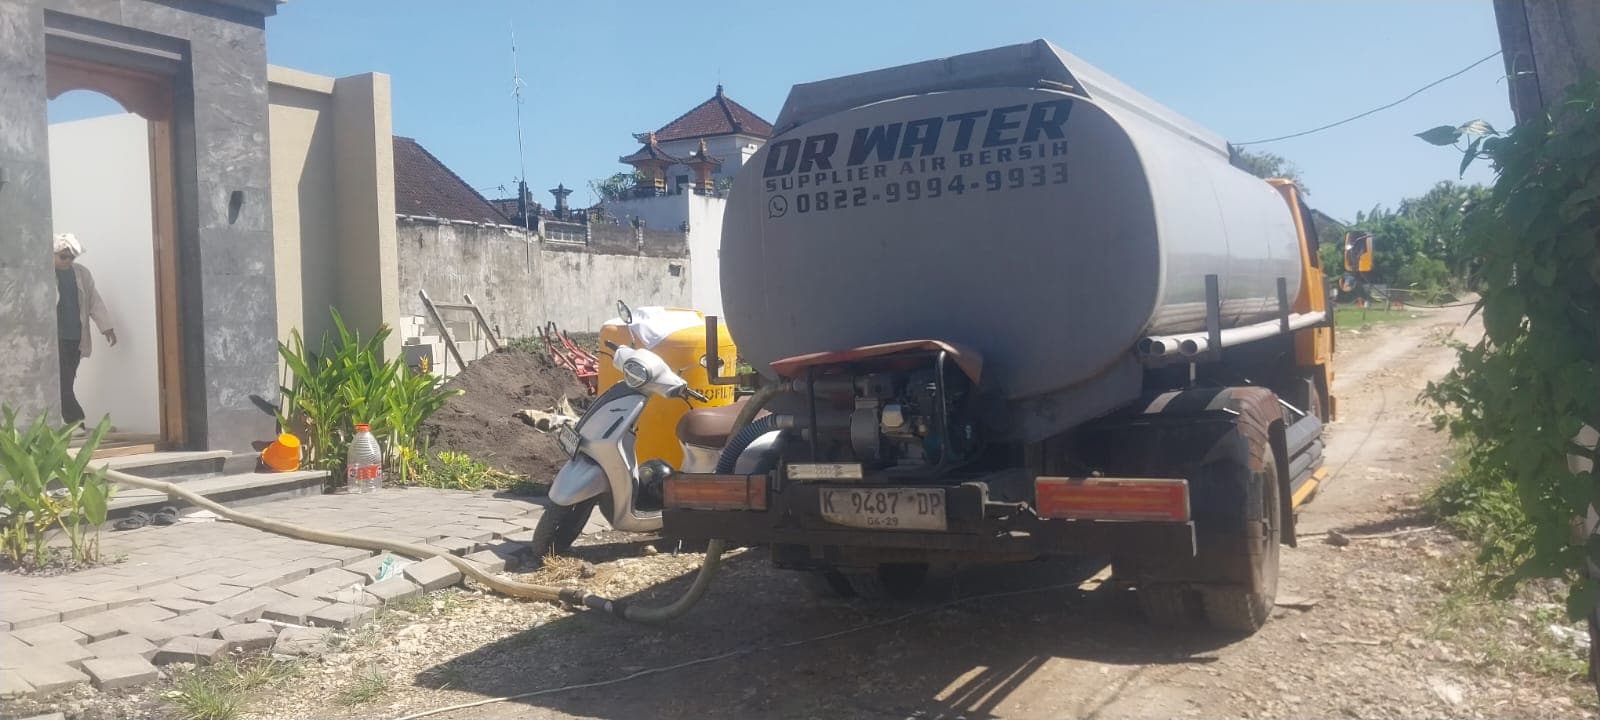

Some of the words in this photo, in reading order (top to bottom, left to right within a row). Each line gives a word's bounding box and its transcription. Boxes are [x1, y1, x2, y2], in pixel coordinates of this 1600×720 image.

[764, 132, 838, 178] DR
[846, 100, 1074, 167] WATER
[766, 164, 888, 192] SUPPLIER
[900, 156, 946, 176] AIR
[959, 140, 1069, 168] BERSIH
[796, 162, 1069, 214] 0822-9994-9933
[823, 491, 836, 514] K
[851, 491, 899, 514] 9487
[917, 492, 941, 515] DP
